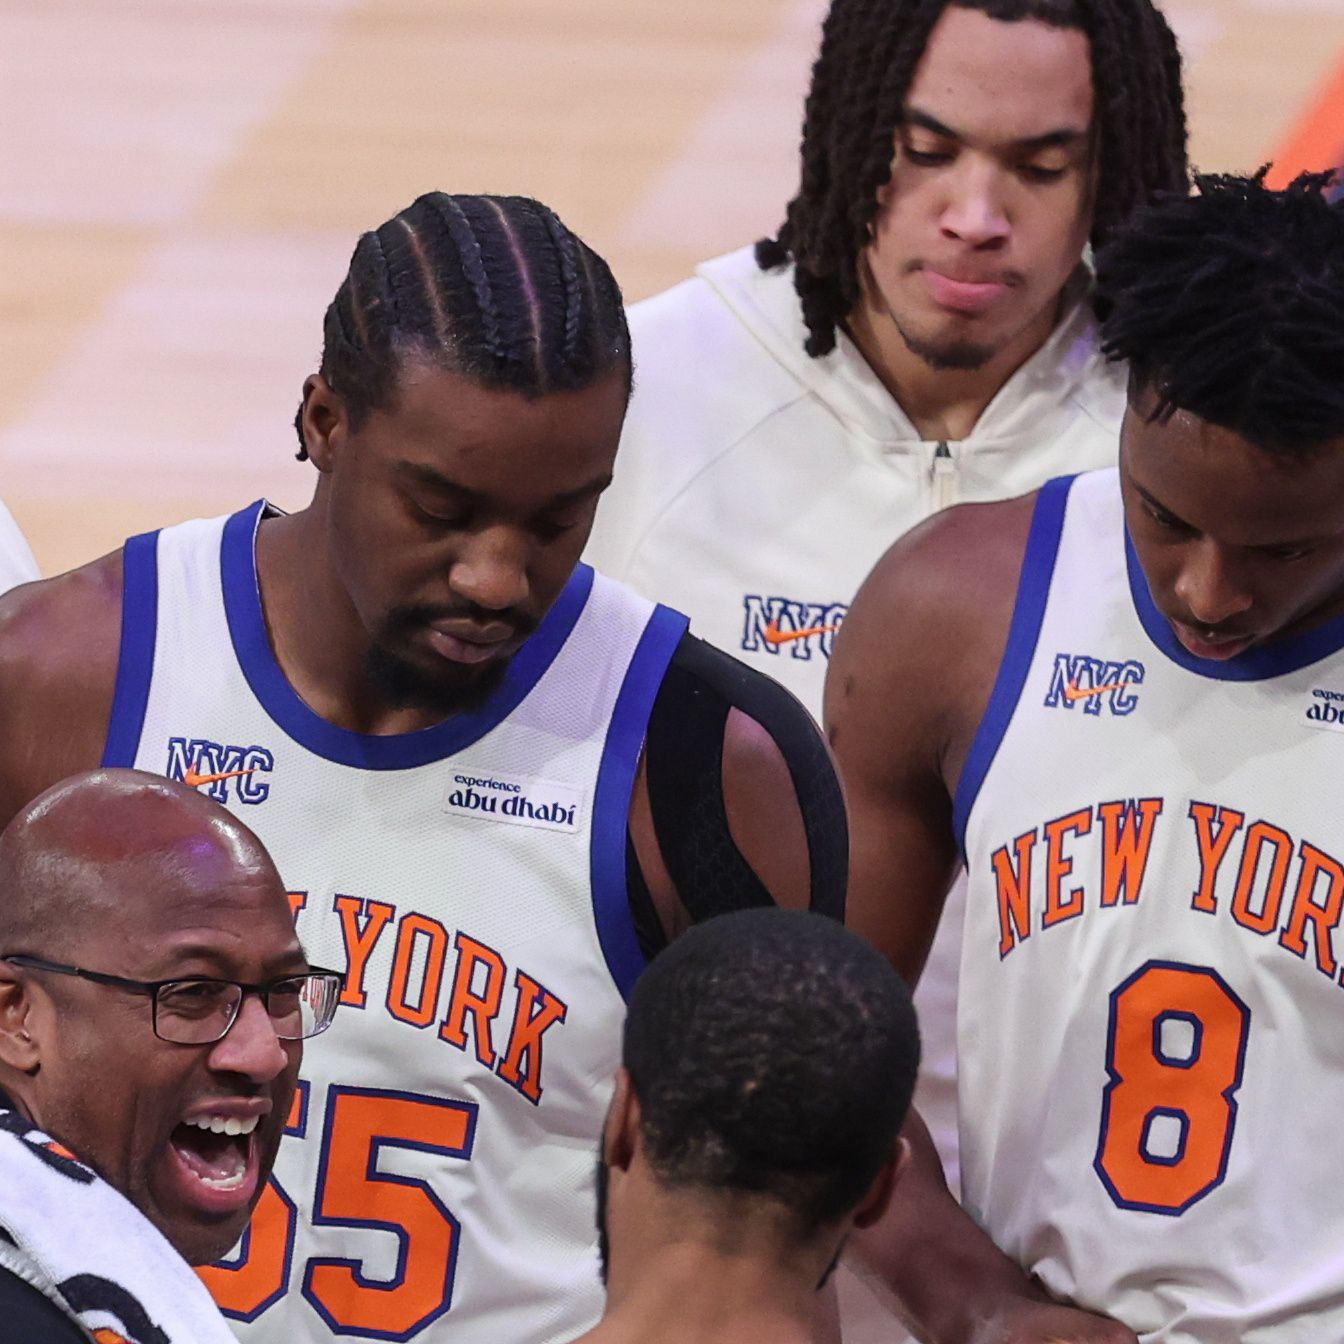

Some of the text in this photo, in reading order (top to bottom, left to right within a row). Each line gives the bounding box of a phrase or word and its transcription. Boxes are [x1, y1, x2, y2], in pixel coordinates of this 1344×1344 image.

[1044, 653, 1145, 716] NYC
[166, 736, 274, 805] NYC
[454, 774, 522, 793] experience
[448, 788, 577, 826] abu dhabi
[991, 797, 1163, 961] NEW
[333, 892, 568, 1106] YORK
[1092, 959, 1252, 1217] 8
